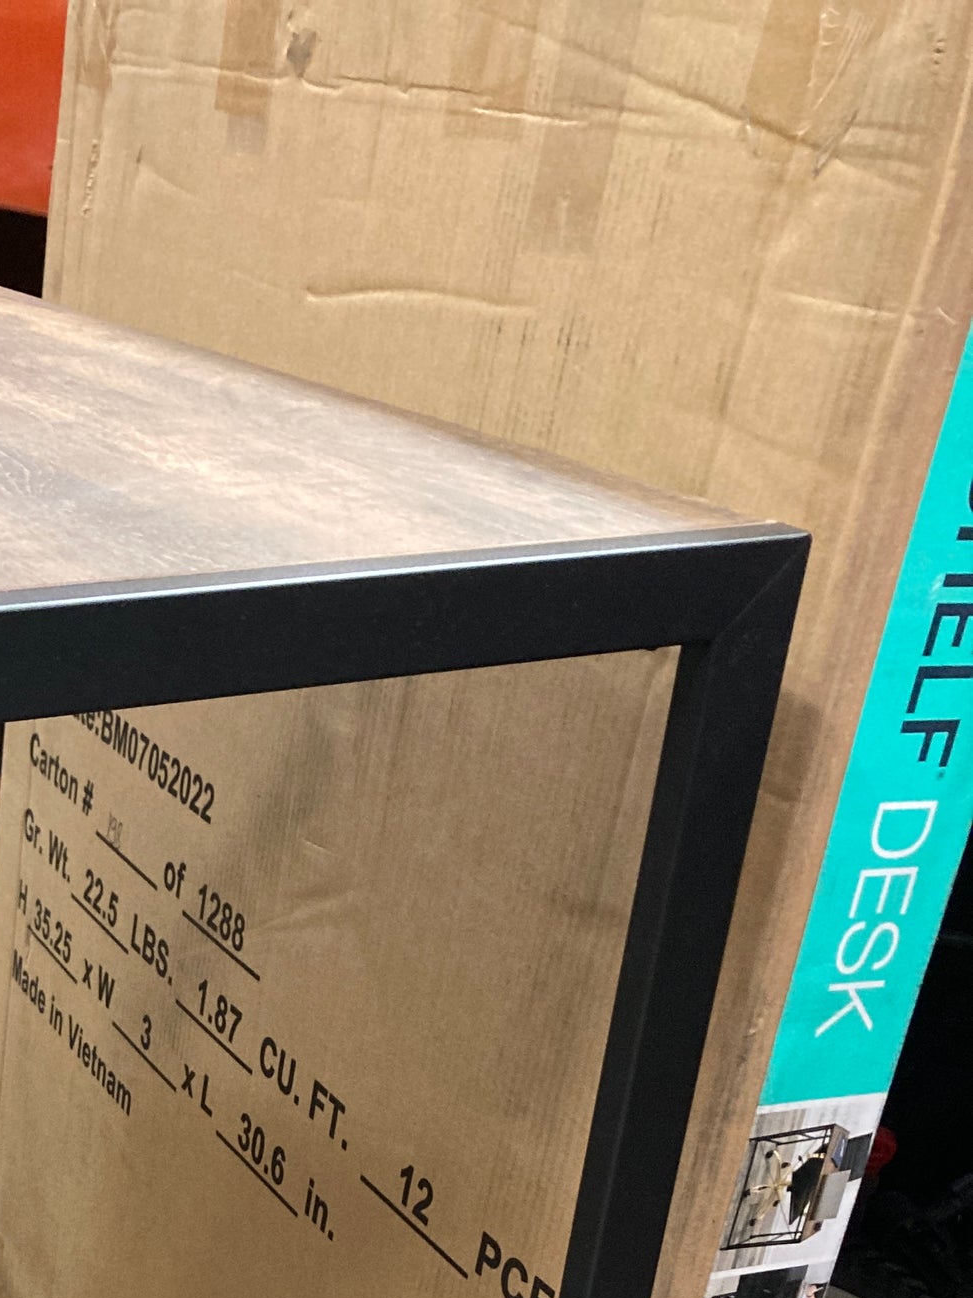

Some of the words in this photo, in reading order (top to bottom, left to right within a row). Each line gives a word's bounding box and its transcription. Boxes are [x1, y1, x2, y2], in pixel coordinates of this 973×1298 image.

[900, 478, 973, 767] ELF
[30, 733, 77, 804] Carton
[82, 780, 94, 816] #
[164, 862, 186, 898] of
[198, 884, 245, 951] 1288
[73, 710, 215, 824] e:BM07052022
[13, 949, 46, 1014] Made
[49, 995, 63, 1036] in
[68, 1014, 132, 1116] Vietnam
[24, 808, 43, 854] Gr.
[49, 829, 70, 882] Wt.
[83, 869, 119, 927] 22.5
[130, 913, 173, 986] LBS.
[198, 979, 242, 1043] 1.87
[260, 1037, 299, 1106] CU.
[309, 1079, 347, 1151] FT.
[400, 1165, 434, 1226] 12
[814, 800, 938, 1038] DESK
[18, 879, 28, 915] H
[34, 898, 72, 963] 35.25
[82, 958, 93, 989] x
[98, 965, 115, 1009] W
[141, 1014, 152, 1050] 3
[181, 1064, 195, 1098] x
[200, 1074, 212, 1118] L
[238, 1113, 285, 1185] 30.6
[304, 1177, 334, 1241] in.
